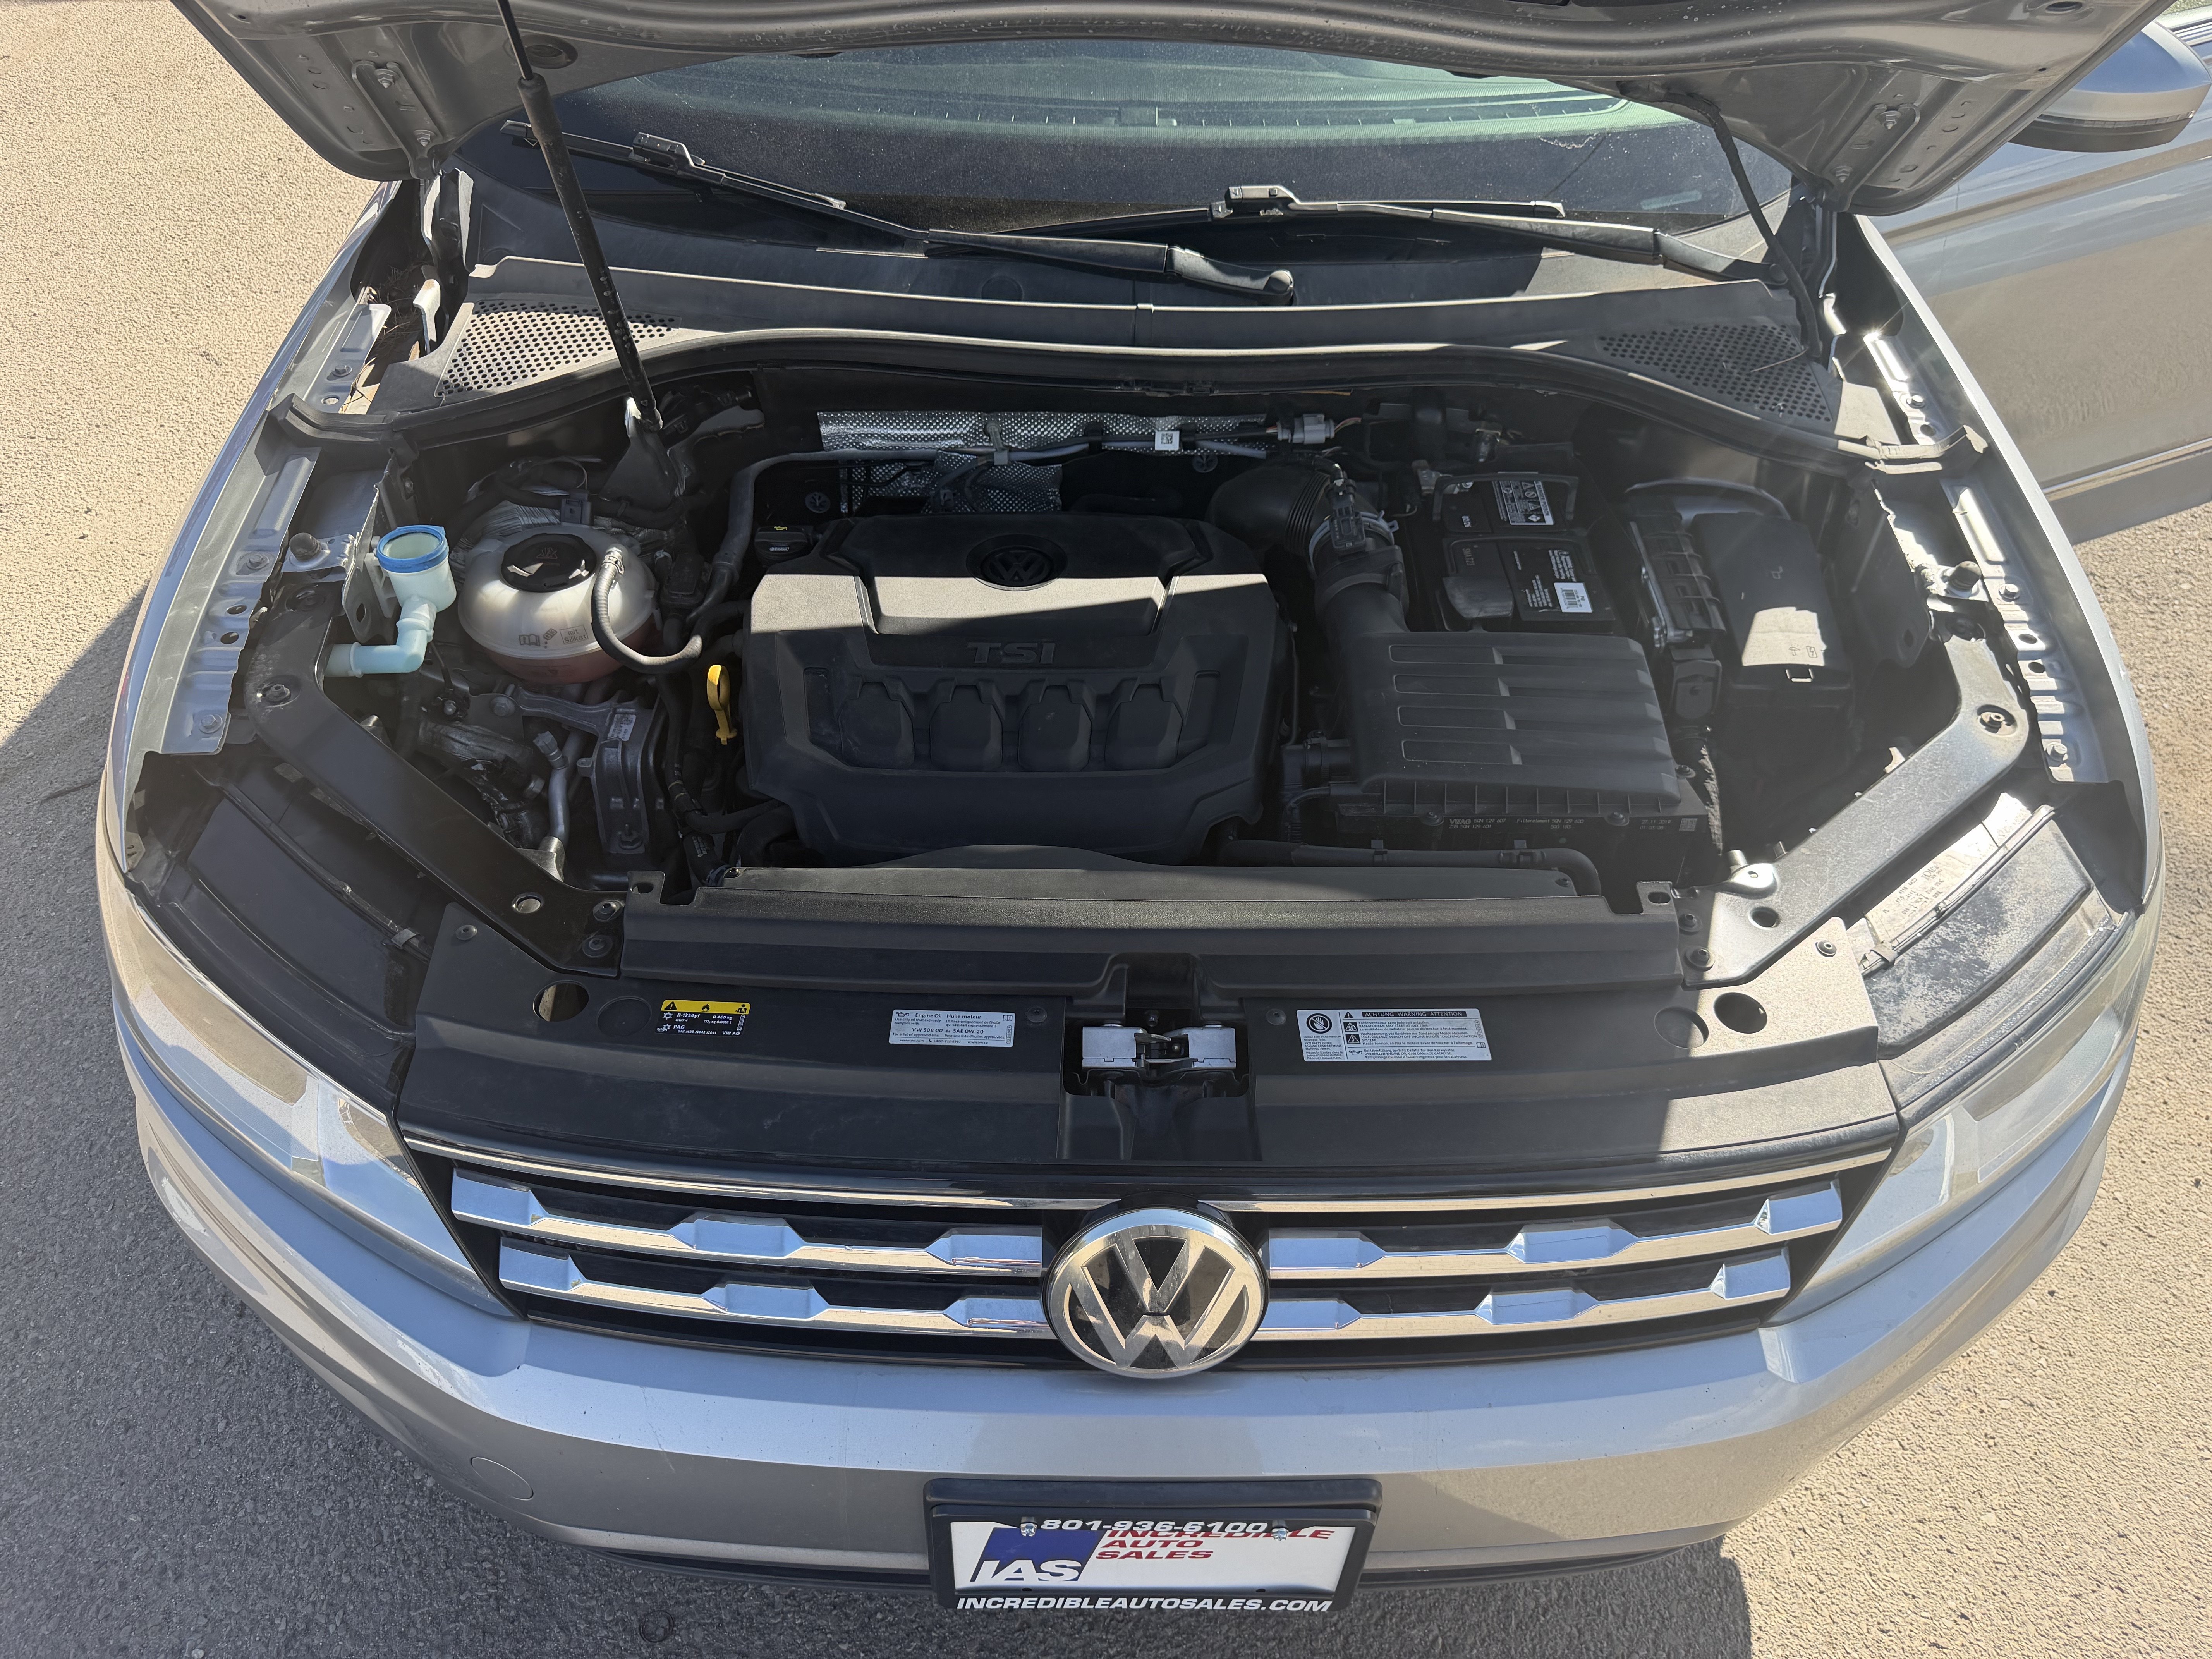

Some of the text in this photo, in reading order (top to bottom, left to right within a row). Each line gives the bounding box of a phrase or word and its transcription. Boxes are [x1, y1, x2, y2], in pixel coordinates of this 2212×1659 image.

[564, 634, 587, 643] Silikat
[967, 642, 1056, 664] TSI
[1041, 1519, 1268, 1533] 801-936-6100
[1100, 1540, 1203, 1549] AUTO
[1095, 1550, 1214, 1559] SALES
[975, 1559, 1082, 1582] IAS
[956, 1597, 1333, 1612] INCREDIBLEAUTOSALES.COM
